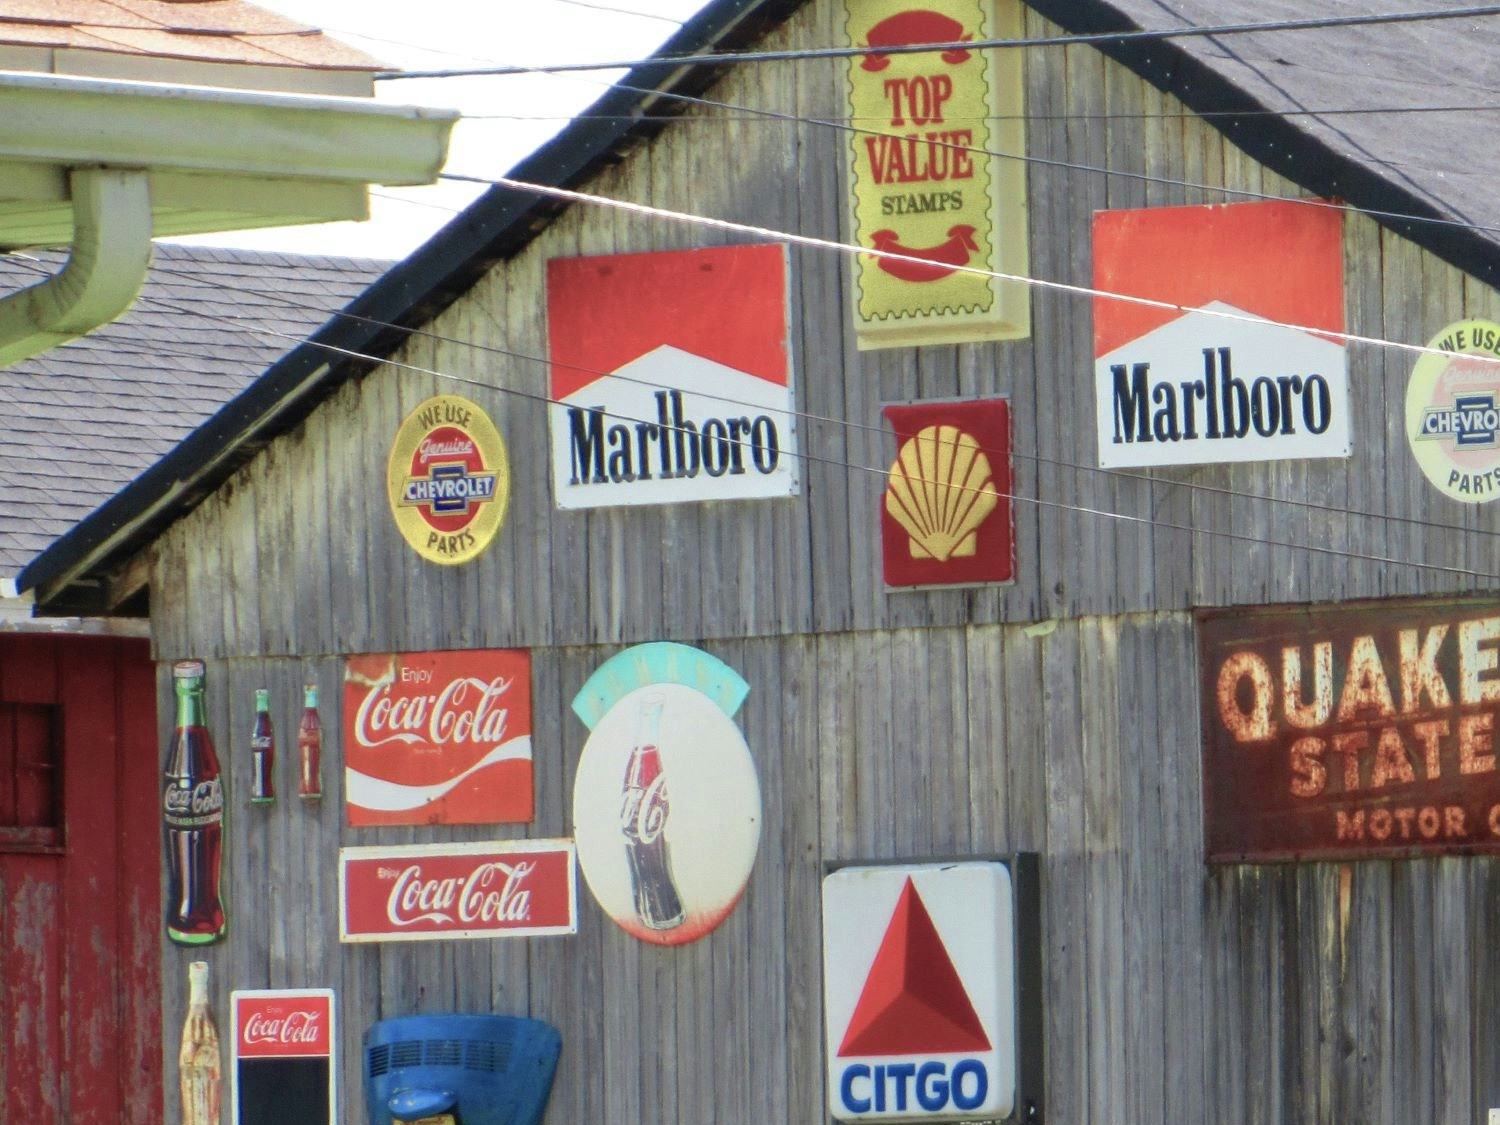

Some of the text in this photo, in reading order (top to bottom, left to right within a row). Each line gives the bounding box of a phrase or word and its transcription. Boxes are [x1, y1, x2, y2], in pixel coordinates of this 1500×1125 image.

[884, 74, 952, 127] TOP
[865, 130, 974, 185] VALUE
[881, 191, 963, 216] STAMPS
[1439, 330, 1466, 358] WE
[1110, 347, 1332, 444] Marlboro
[418, 403, 472, 431] WE USE
[420, 438, 474, 464] Genuine
[568, 390, 779, 487] Marlboro
[406, 478, 493, 500] CHEVROLET
[427, 528, 475, 553] PARTS
[402, 667, 434, 684] Enjoy
[355, 675, 515, 748] Coca-Cola
[1287, 712, 1497, 800] STATE
[1336, 808, 1468, 842] MOTOR
[387, 860, 537, 927] Coca-Cola
[243, 1010, 322, 1045] Coca-Cola
[839, 1058, 990, 1115] CITGO
